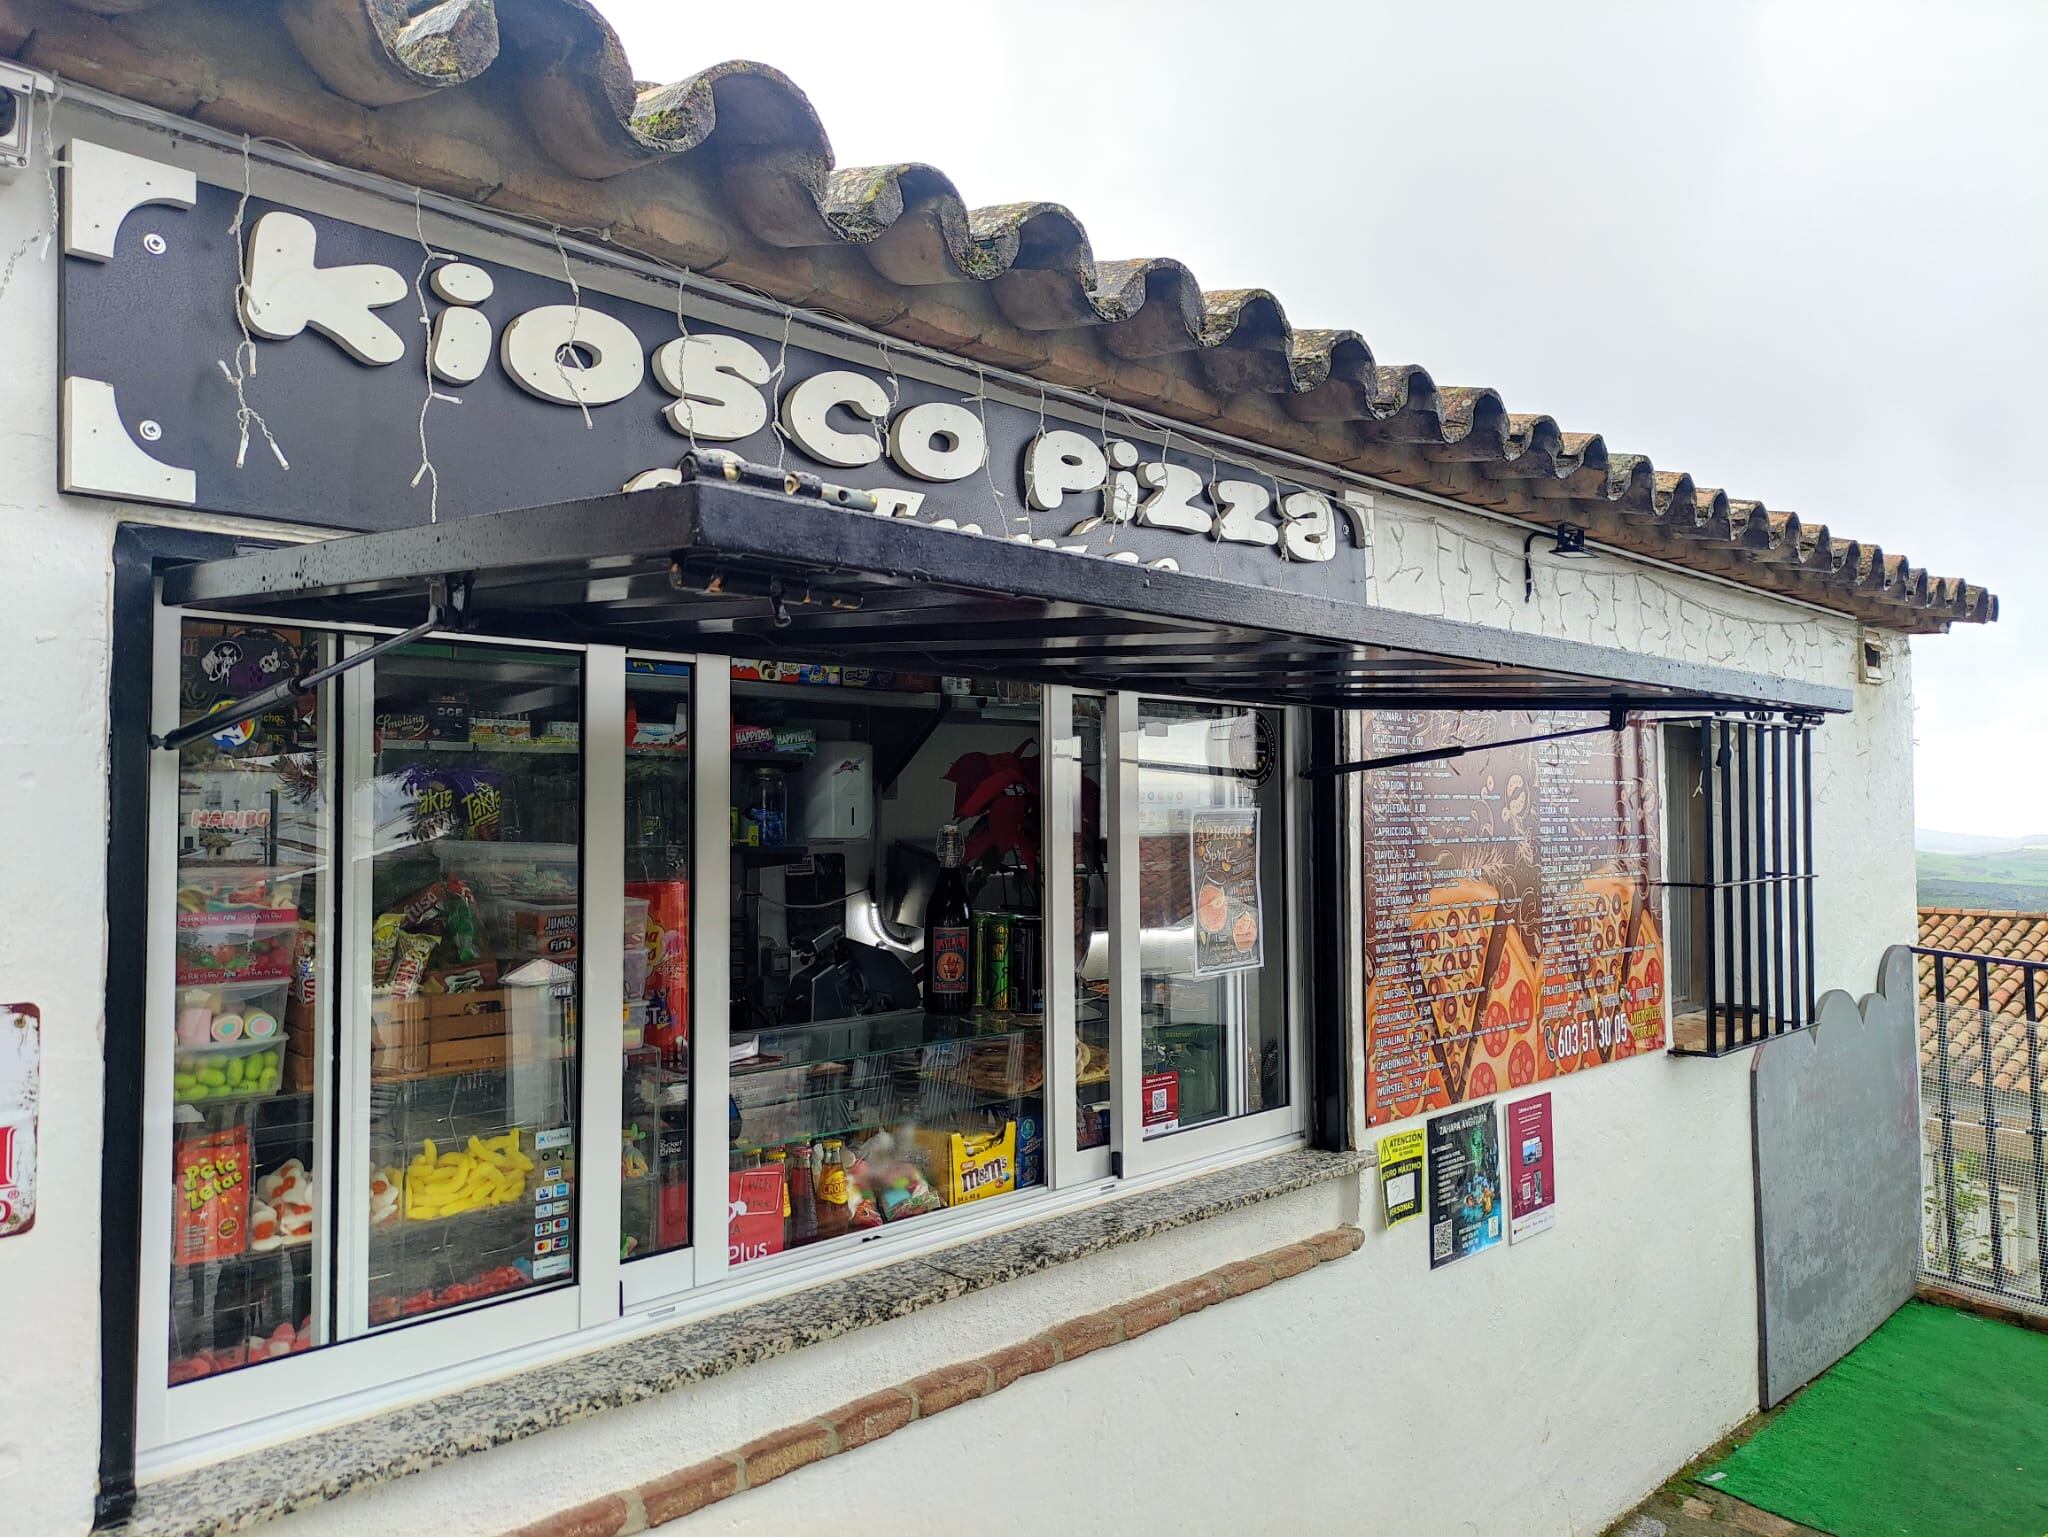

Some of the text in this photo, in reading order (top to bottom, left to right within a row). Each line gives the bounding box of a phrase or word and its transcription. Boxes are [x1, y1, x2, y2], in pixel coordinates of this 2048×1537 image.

[376, 713, 426, 731] Smoking
[191, 809, 271, 829] HARIBO
[1196, 825, 1244, 843] APEROL
[1203, 841, 1235, 868] Spritz
[545, 915, 577, 930] JUMBO
[1558, 1013, 1627, 1058] 603 51 30 05
